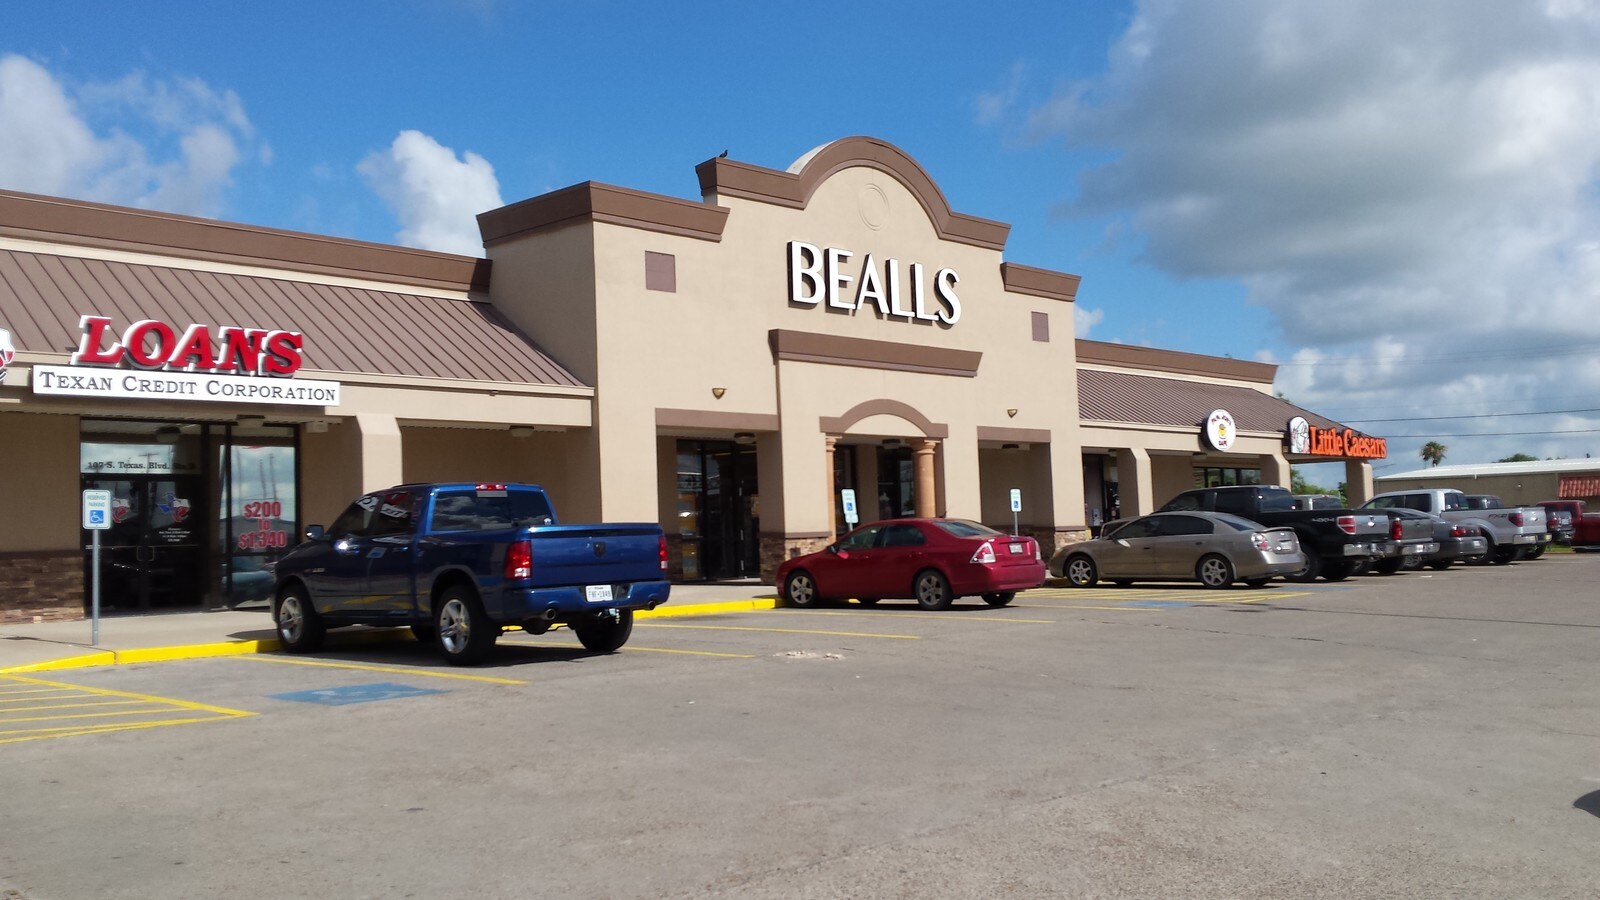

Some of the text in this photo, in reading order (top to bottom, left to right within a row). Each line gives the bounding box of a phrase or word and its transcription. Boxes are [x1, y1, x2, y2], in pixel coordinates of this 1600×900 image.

[787, 240, 962, 325] BEALLS
[70, 315, 303, 376] LOANS
[39, 371, 336, 402] TEXAN CREDIT CORPORATION
[1310, 426, 1387, 459] Little Caesars
[244, 501, 281, 518] $200
